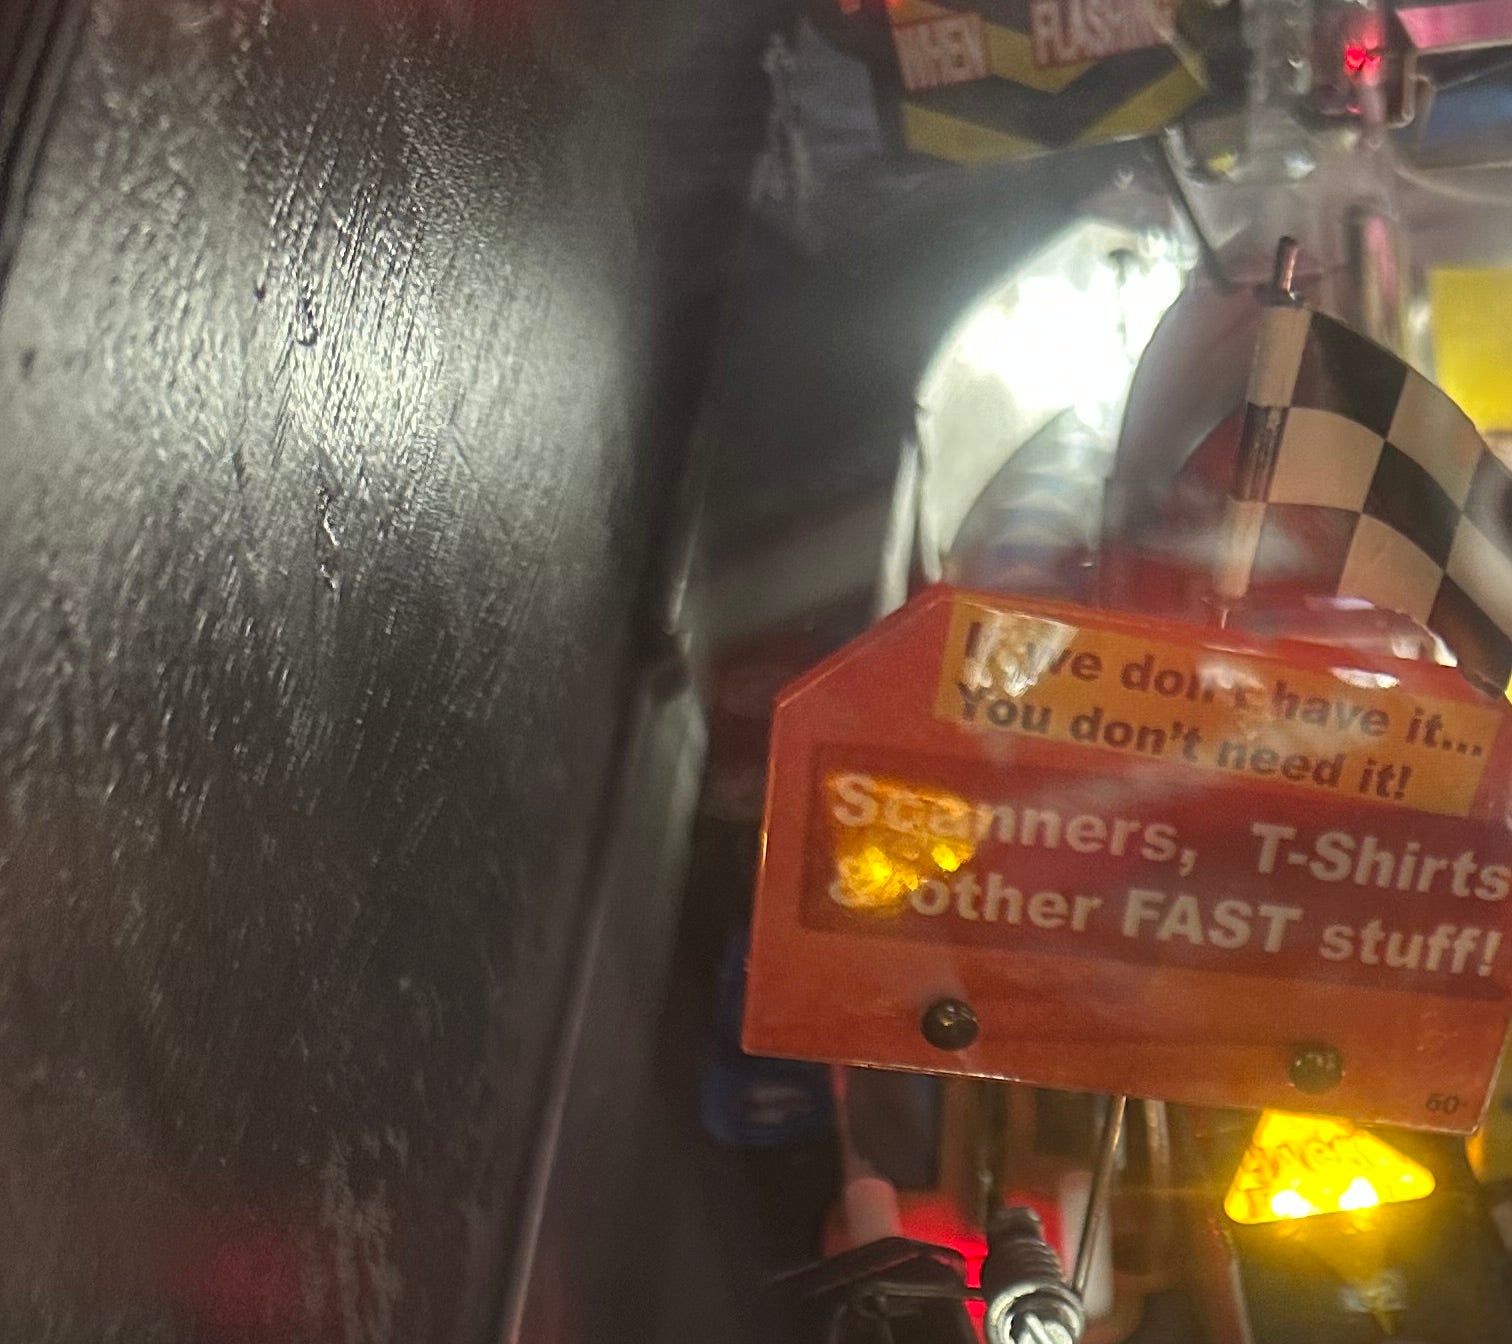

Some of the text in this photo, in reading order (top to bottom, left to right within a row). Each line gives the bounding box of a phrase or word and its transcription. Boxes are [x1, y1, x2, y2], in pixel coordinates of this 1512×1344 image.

[956, 683, 1412, 802] You don't need it!
[1273, 681, 1388, 737] have
[1406, 706, 1485, 759] it...
[833, 771, 1512, 902] Scanners, T-Shirts
[911, 870, 1100, 934] other
[1122, 887, 1302, 955] FAST
[1322, 915, 1503, 977] stuff!
